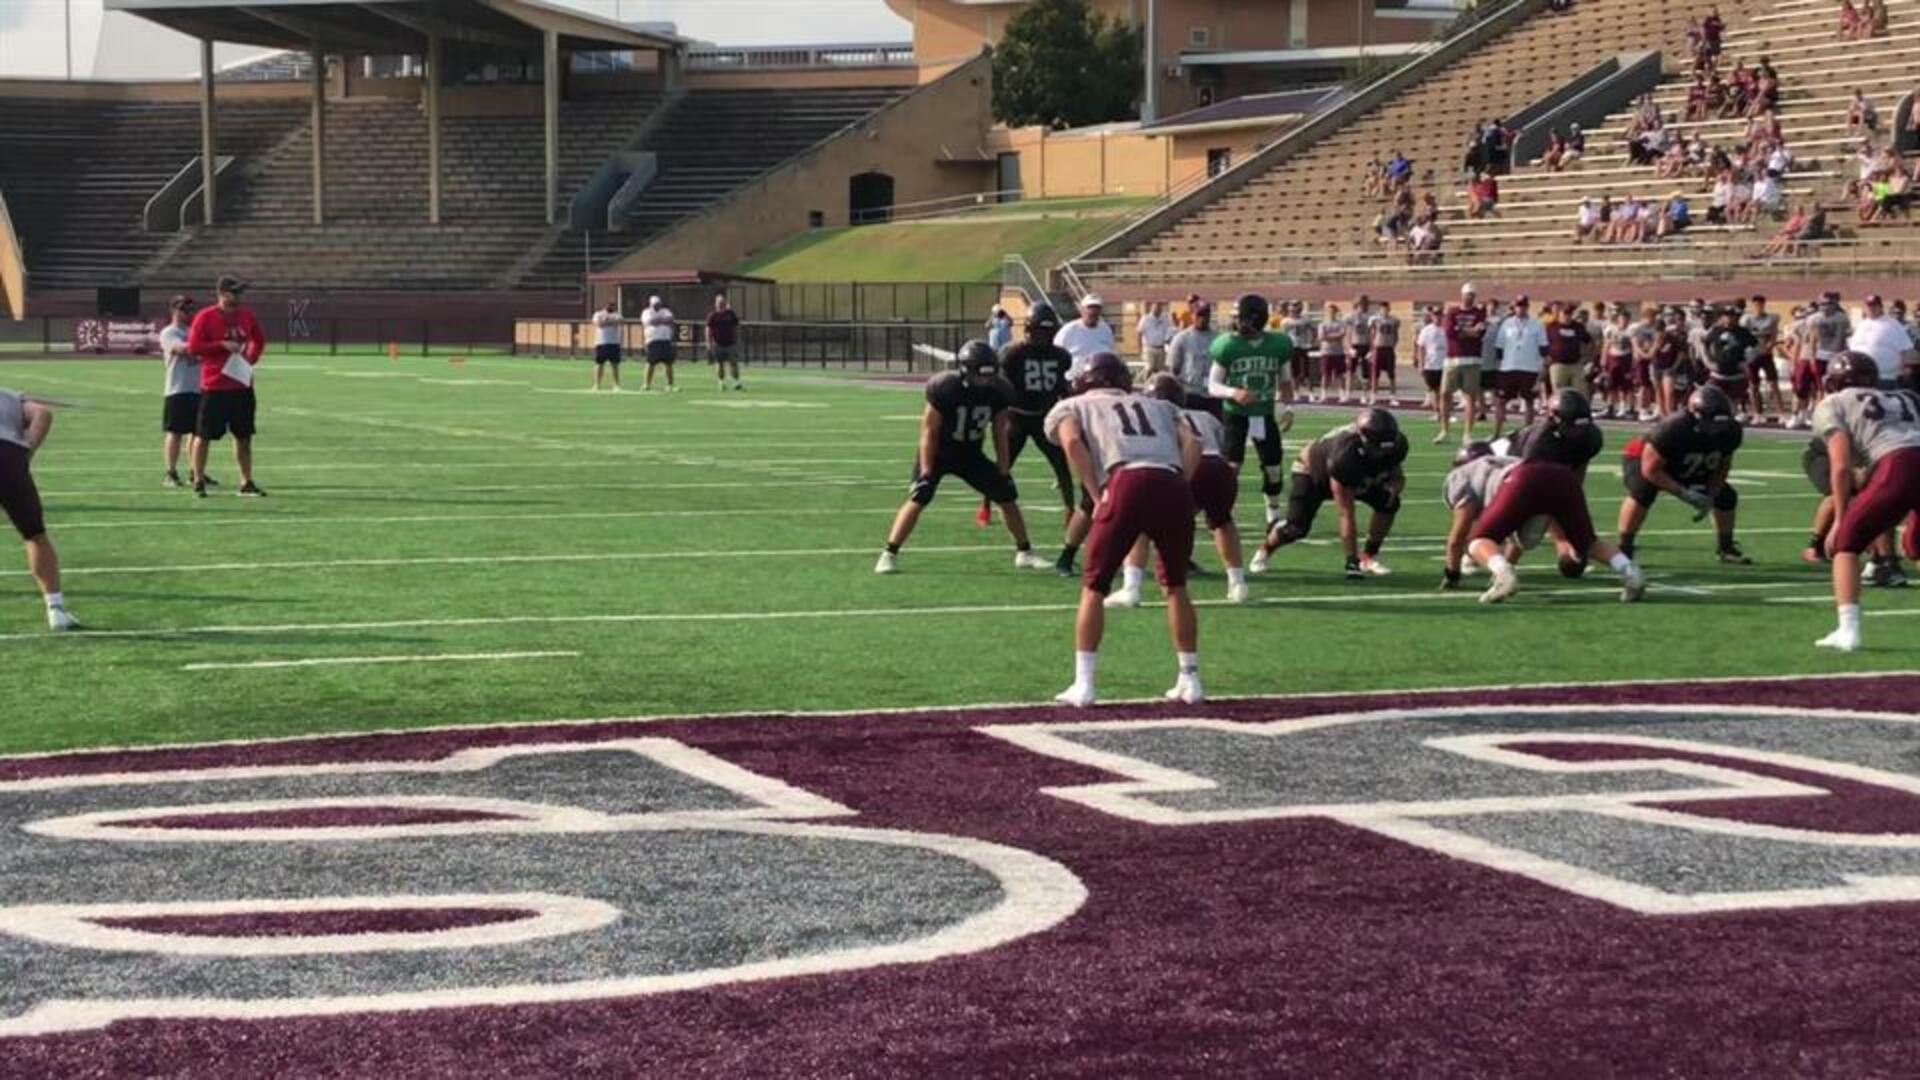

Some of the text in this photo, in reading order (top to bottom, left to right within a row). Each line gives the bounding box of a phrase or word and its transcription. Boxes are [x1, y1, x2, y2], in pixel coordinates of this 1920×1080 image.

[1023, 359, 1059, 392] 25
[1230, 355, 1280, 374] CENTRAL
[951, 404, 993, 442] 13
[1112, 401, 1157, 438] 11
